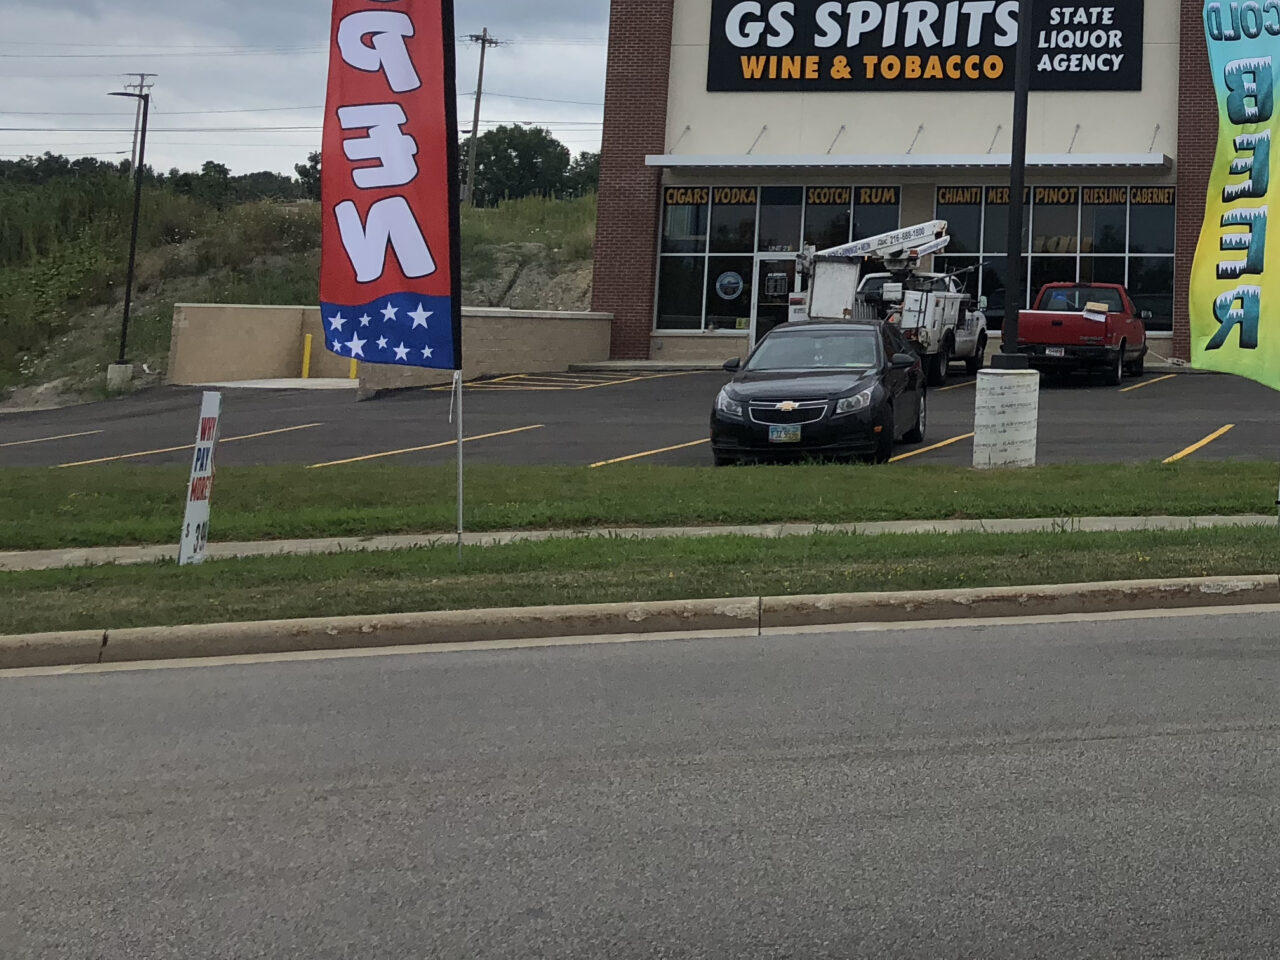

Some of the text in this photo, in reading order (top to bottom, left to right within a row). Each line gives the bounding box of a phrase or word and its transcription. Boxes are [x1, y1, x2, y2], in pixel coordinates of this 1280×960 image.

[1049, 6, 1115, 25] STATE
[724, 0, 1020, 48] GS SPIRITS
[1037, 29, 1123, 49] LIQUOR
[740, 54, 1005, 80] WINE & TOBACCO
[1036, 53, 1124, 72] AGENCY
[665, 188, 708, 204] CIGARS
[713, 188, 757, 204] VODKA
[807, 188, 850, 204] SCOTCH
[859, 188, 896, 204] RUM
[938, 188, 982, 204] CHIANTI
[986, 188, 1030, 204] MERT
[1034, 188, 1078, 204] PINOT
[1083, 188, 1127, 204] RIESLING
[1130, 188, 1175, 204] CABERNET
[194, 446, 211, 473] PAY
